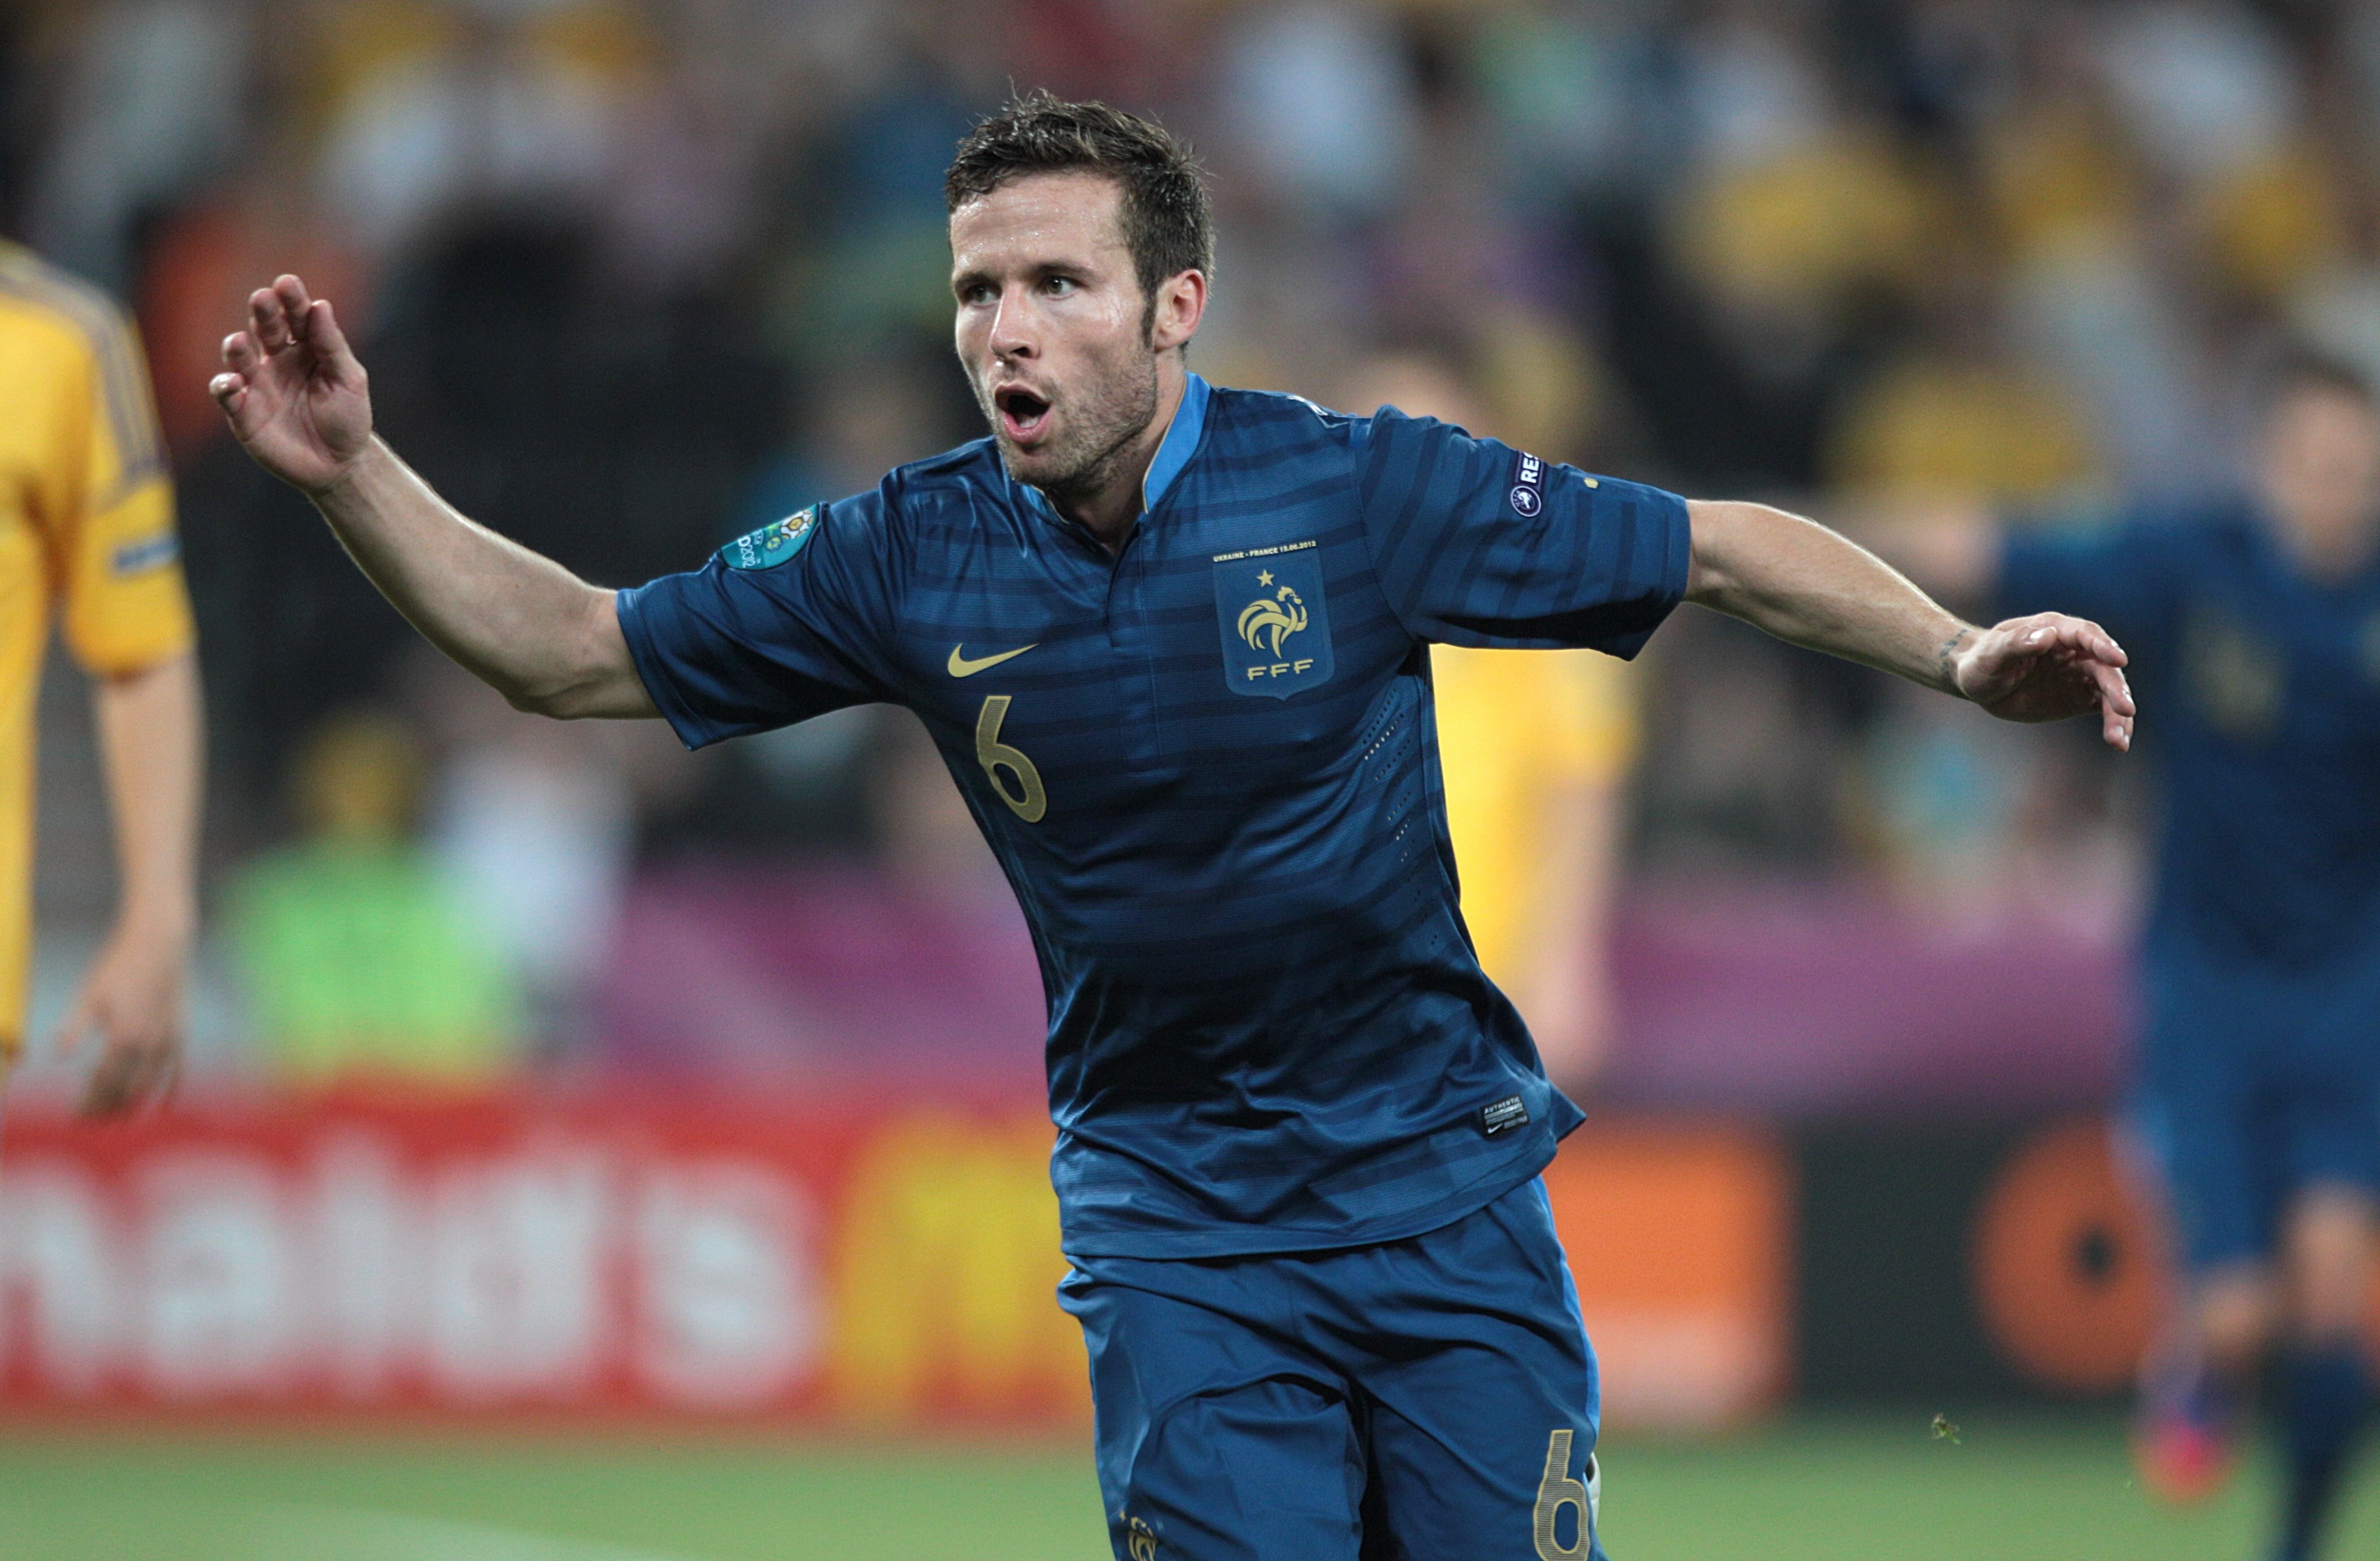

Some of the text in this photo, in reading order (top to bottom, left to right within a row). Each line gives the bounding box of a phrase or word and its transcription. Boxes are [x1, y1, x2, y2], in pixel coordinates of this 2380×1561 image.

[1213, 552, 1245, 563] UKRAINE
[1250, 547, 1278, 557] FRANCE
[1279, 540, 1317, 552] 15.06.2012
[1248, 658, 1314, 681] FFF
[976, 696, 1046, 823] 6
[1533, 1429, 1591, 1561] 6
